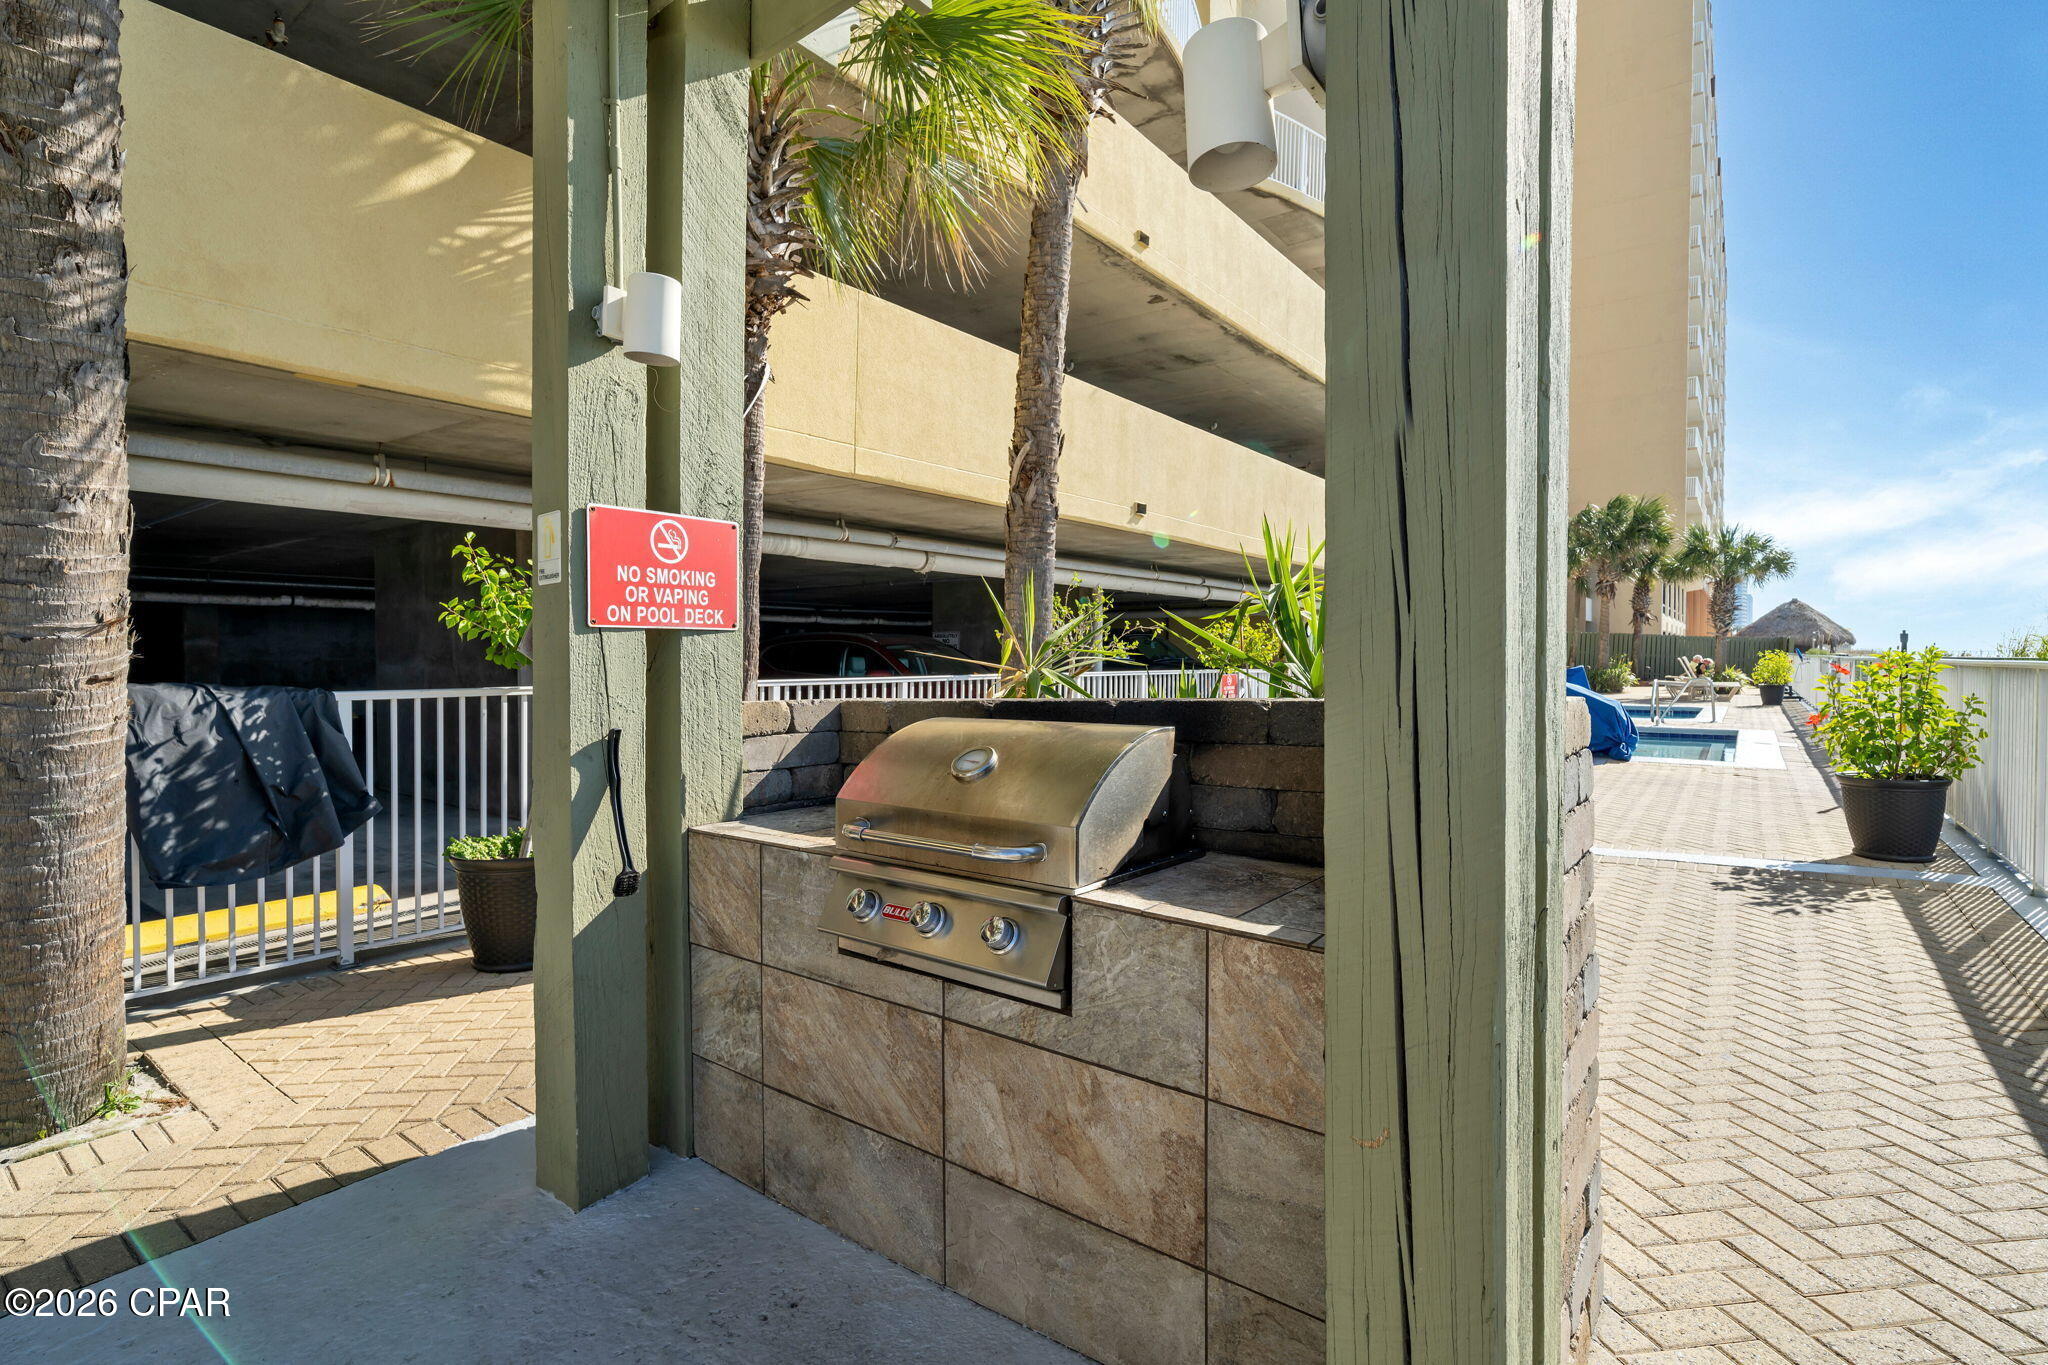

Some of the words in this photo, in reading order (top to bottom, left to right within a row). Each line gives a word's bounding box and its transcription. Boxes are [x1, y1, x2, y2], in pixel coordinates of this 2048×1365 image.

[616, 565, 641, 582] NO
[645, 566, 716, 587] SMOKING
[626, 586, 650, 603] OR
[653, 587, 708, 606] VAPING
[606, 604, 631, 622] ON
[637, 606, 680, 624] POOL
[684, 608, 724, 625] DECK
